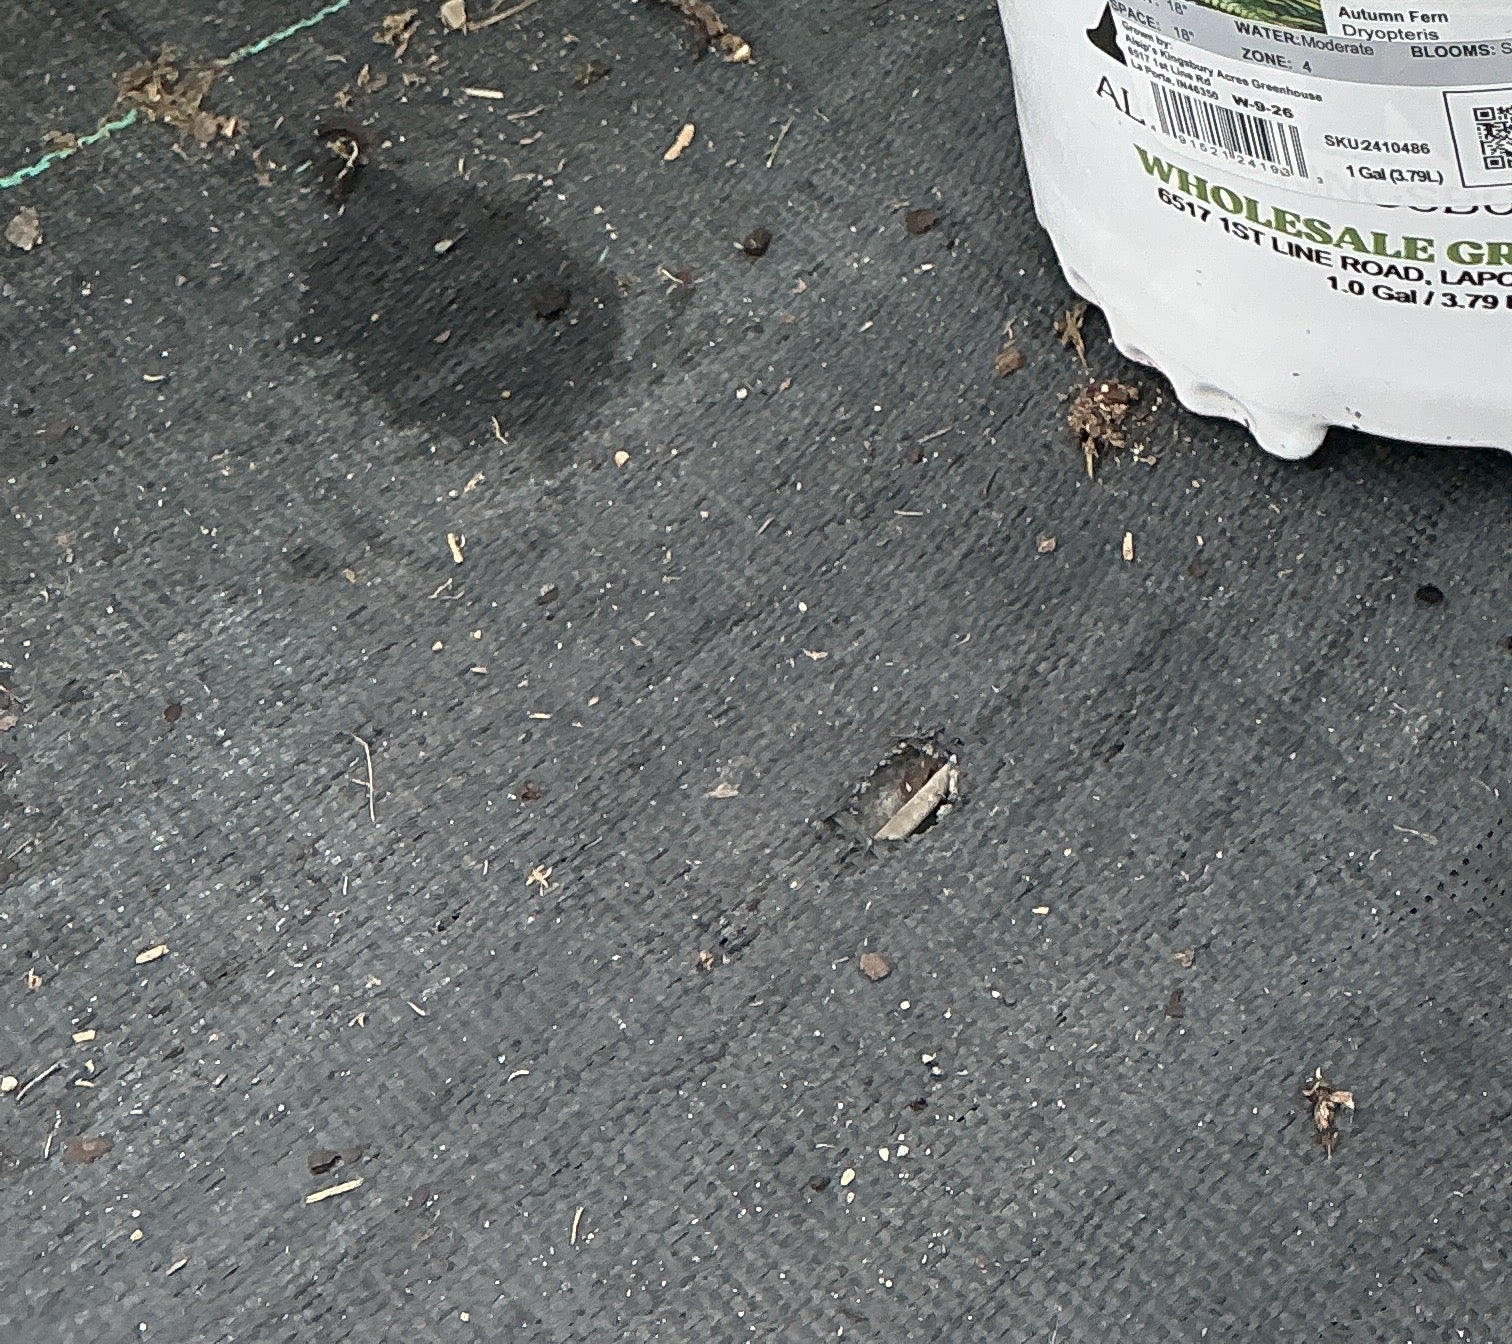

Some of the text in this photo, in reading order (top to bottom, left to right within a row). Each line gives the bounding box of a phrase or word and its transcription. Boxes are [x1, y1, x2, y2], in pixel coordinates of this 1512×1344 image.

[1338, 6, 1449, 24] Autumn Fern
[1122, 20, 1155, 42] Grown
[1235, 20, 1301, 48] WATER:
[1301, 34, 1375, 57] Moderate
[1411, 43, 1498, 59] BLOOMS:
[1342, 23, 1440, 43] Dryopteris
[1125, 34, 1324, 103] Alsip's Kingsbury Acres Greenhouse
[1130, 58, 1143, 72] La
[1153, 57, 1170, 73] 1st
[1172, 67, 1194, 83] Line
[1196, 73, 1212, 87] Rd
[1241, 47, 1313, 74] ZONE: 4
[1232, 94, 1296, 120] W-9-26
[1358, 166, 1387, 182] Gal
[1390, 168, 1445, 187] (3.79L)
[1133, 143, 1436, 264] WHOLESALE
[1157, 186, 1212, 225] 6517
[1218, 215, 1266, 247] 1ST
[1271, 236, 1335, 269] LINE
[1326, 275, 1366, 298] 1.0
[1371, 282, 1419, 306] Gal
[1441, 290, 1501, 310] 3.79
